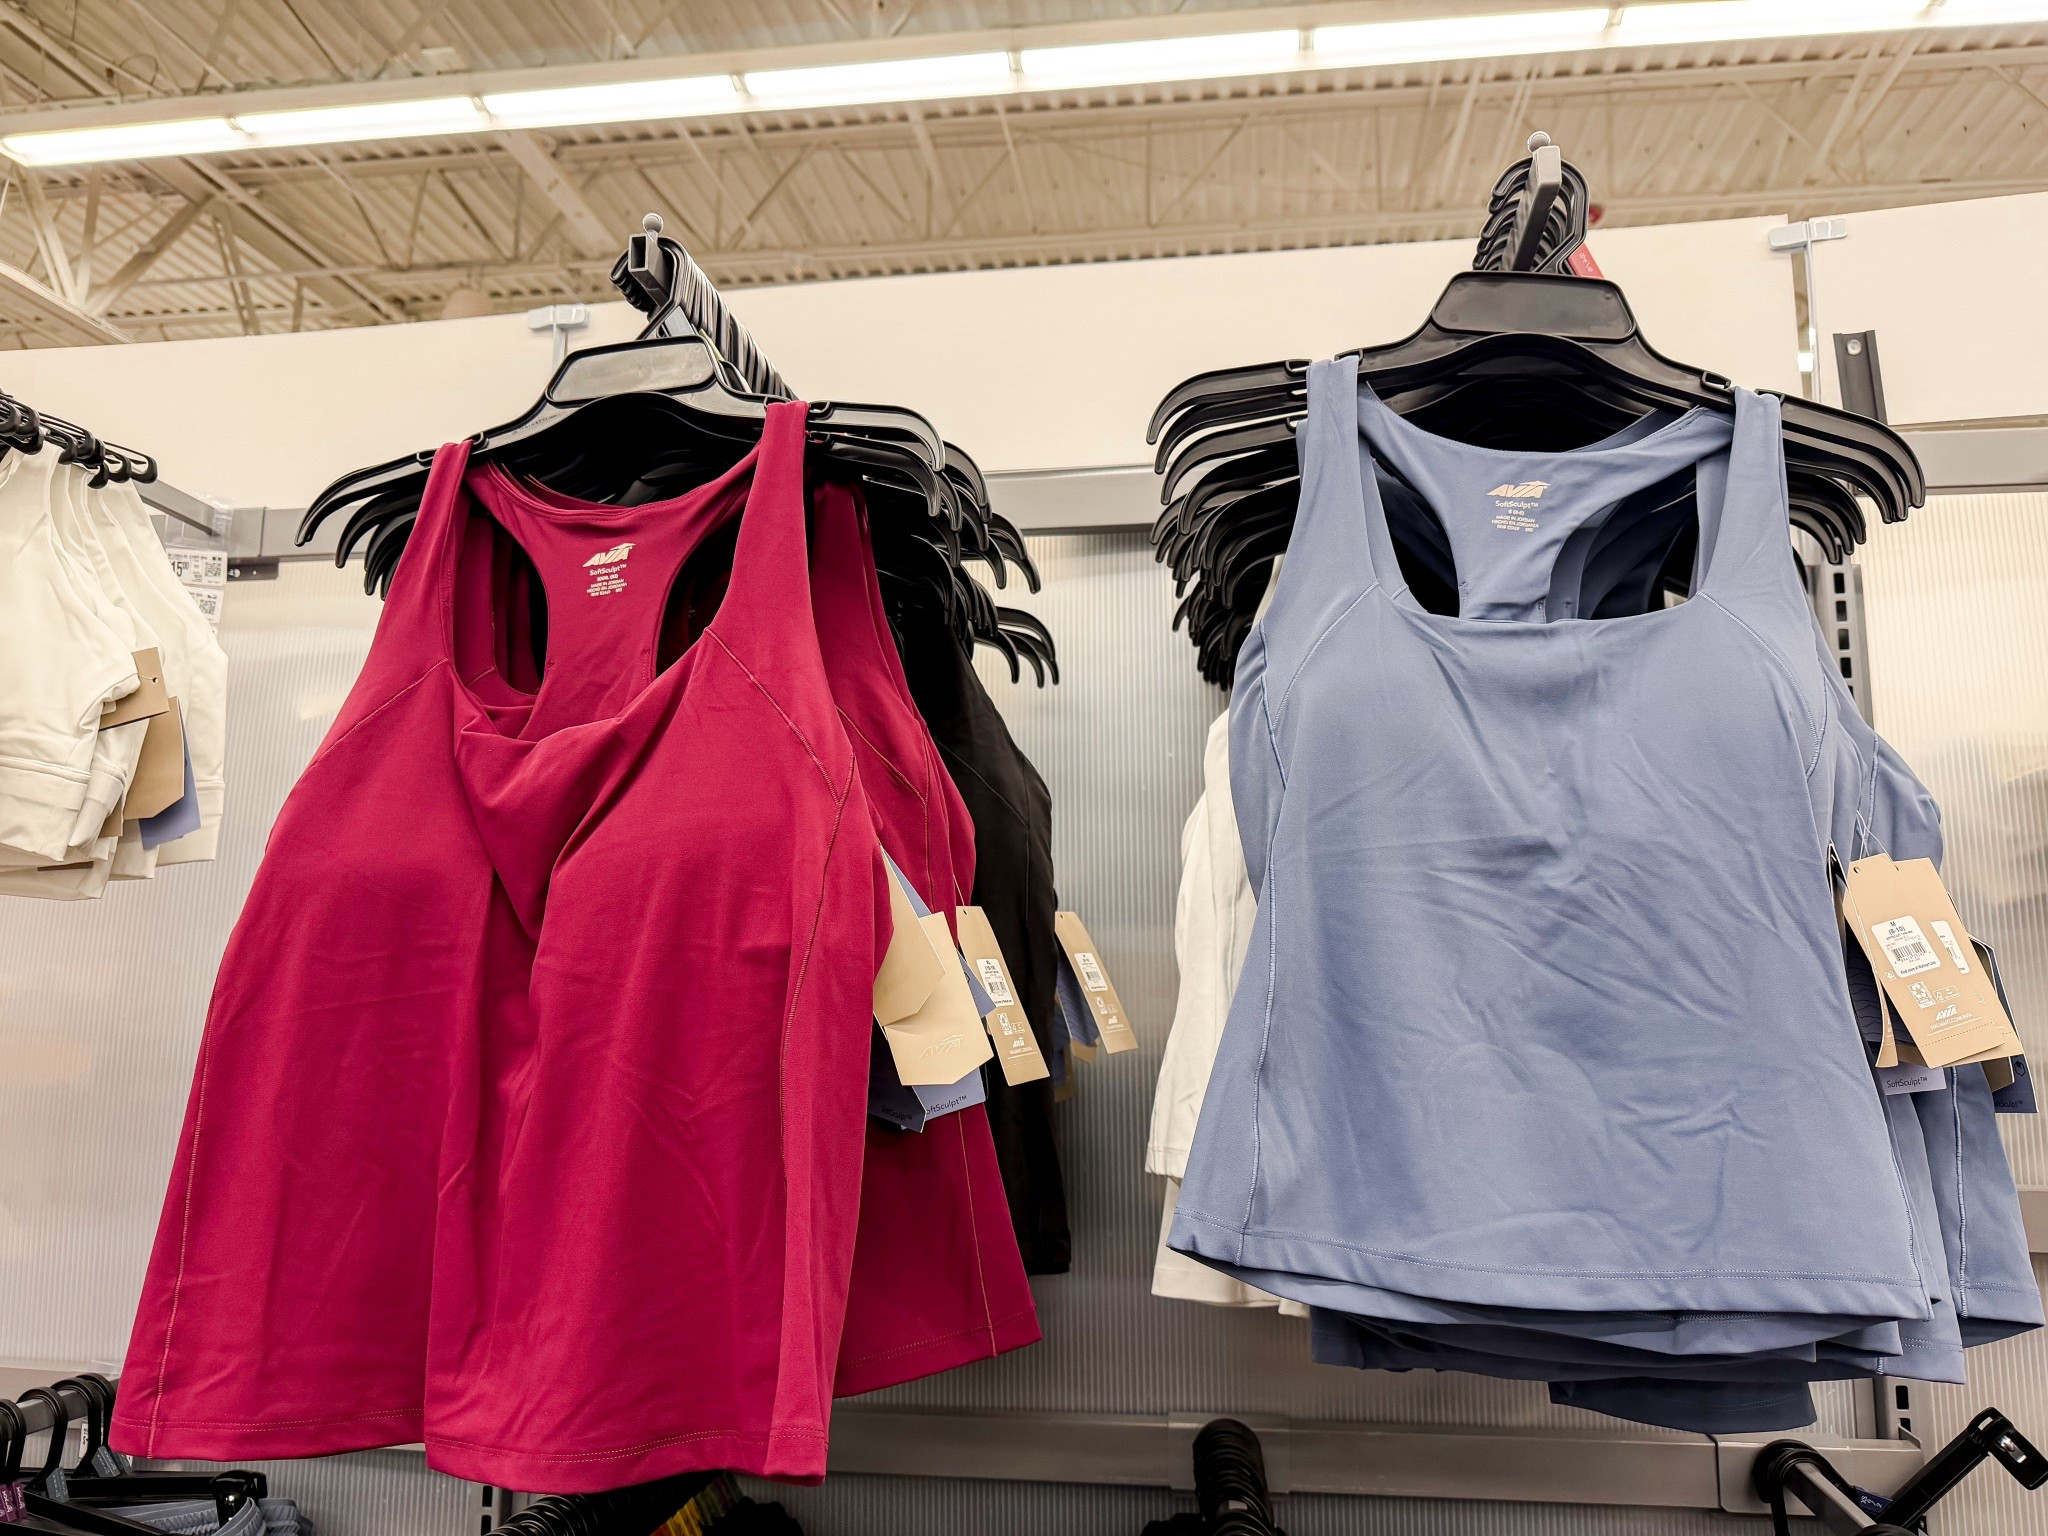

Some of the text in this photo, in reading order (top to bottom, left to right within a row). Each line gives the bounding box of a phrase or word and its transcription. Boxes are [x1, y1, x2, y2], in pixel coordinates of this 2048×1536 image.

[1935, 1004, 1958, 1021] AVIA
[1886, 1076, 1928, 1088] SoftSculpt™
[926, 1095, 967, 1115] oftSculpt™
